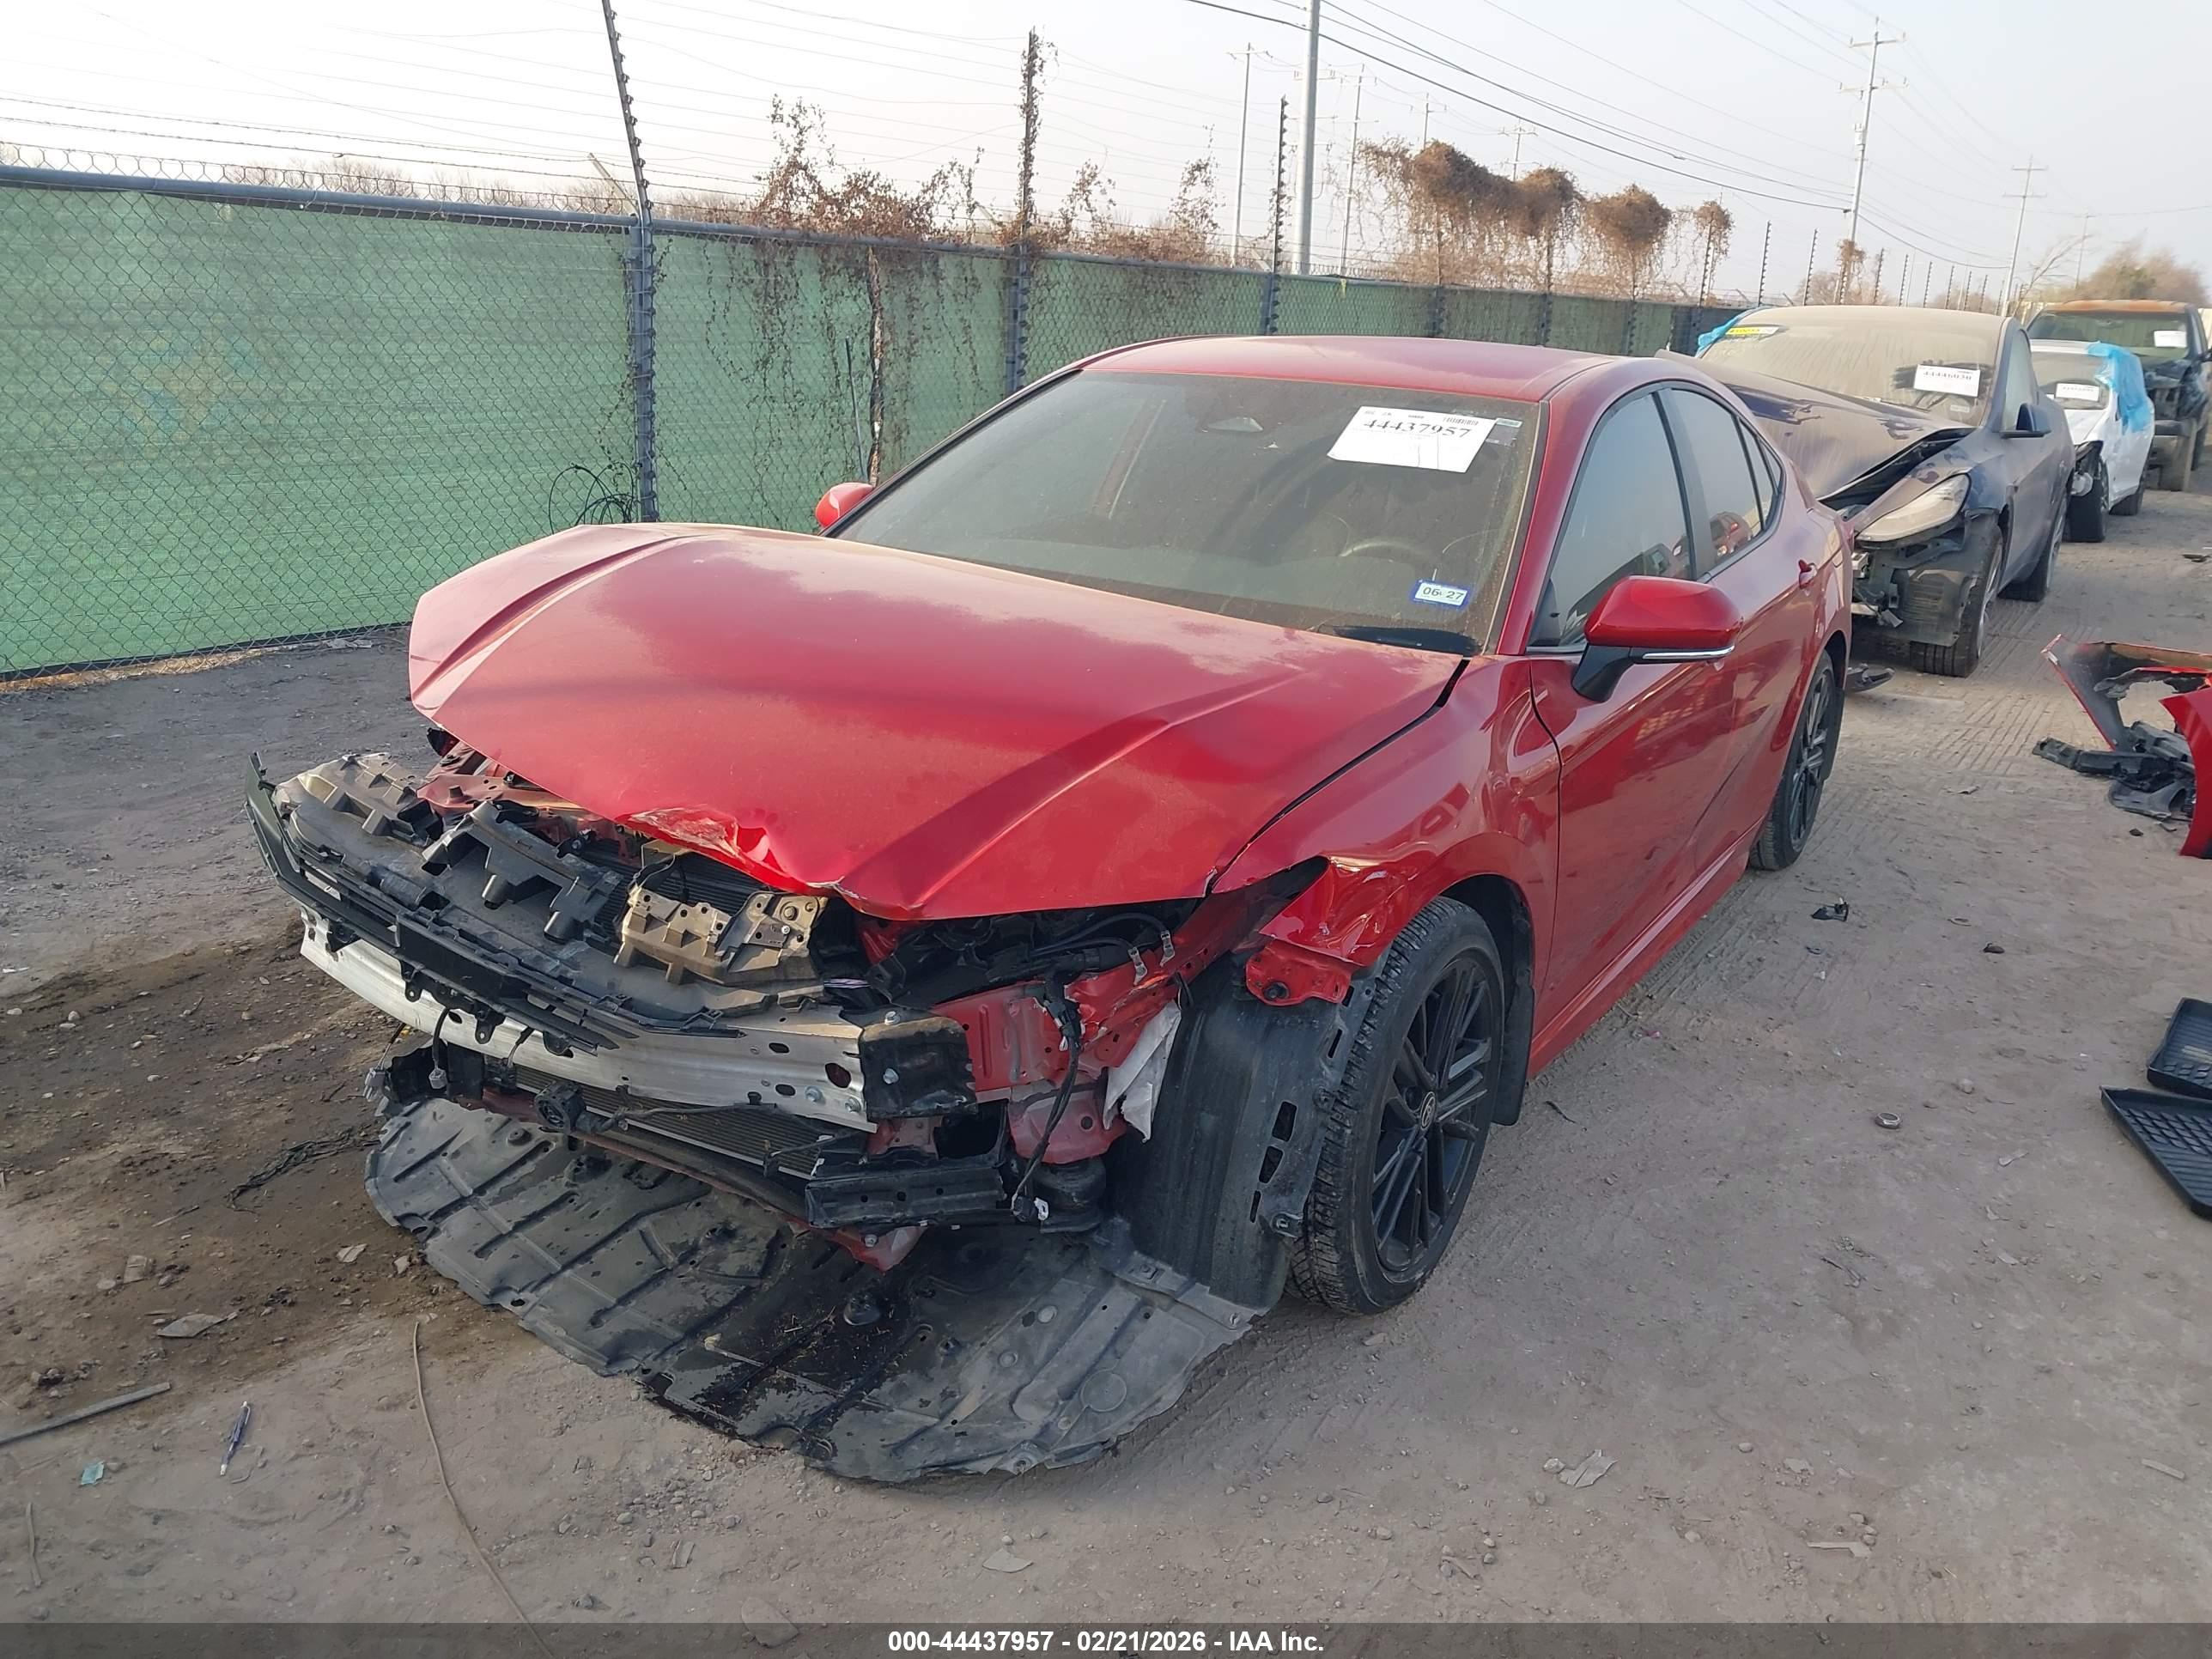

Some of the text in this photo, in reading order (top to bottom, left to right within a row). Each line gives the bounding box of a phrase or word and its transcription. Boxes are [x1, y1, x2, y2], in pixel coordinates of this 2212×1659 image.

[1364, 419, 1473, 438] 44437957
[1422, 586, 1464, 600] 06 27
